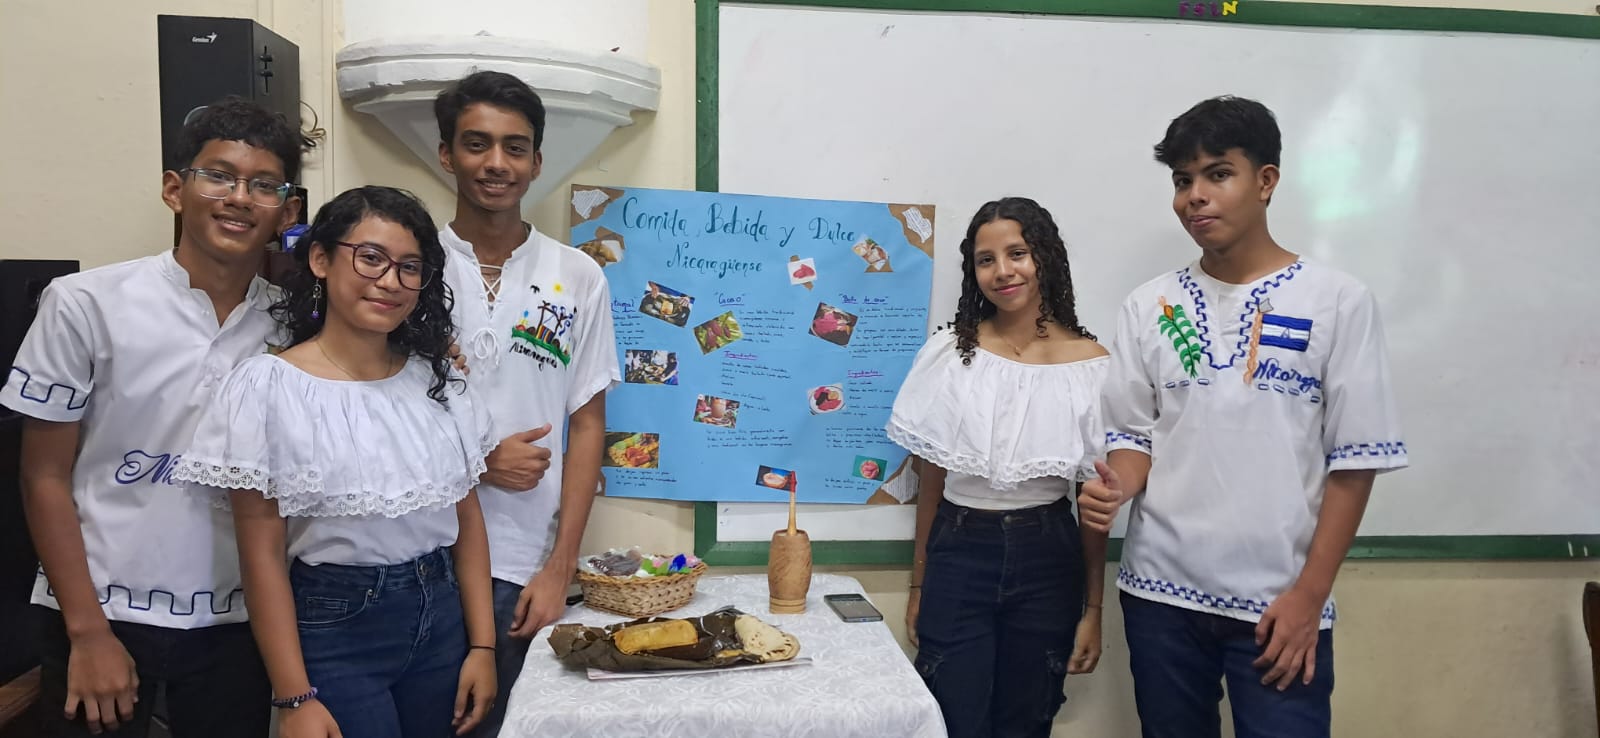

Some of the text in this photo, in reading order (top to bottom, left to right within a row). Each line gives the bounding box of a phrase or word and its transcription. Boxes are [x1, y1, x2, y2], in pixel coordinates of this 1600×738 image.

[705, 202, 769, 242] Bebida
[779, 226, 796, 248] y
[808, 217, 855, 244] Dulce
[667, 242, 763, 279] Nicaragüense
